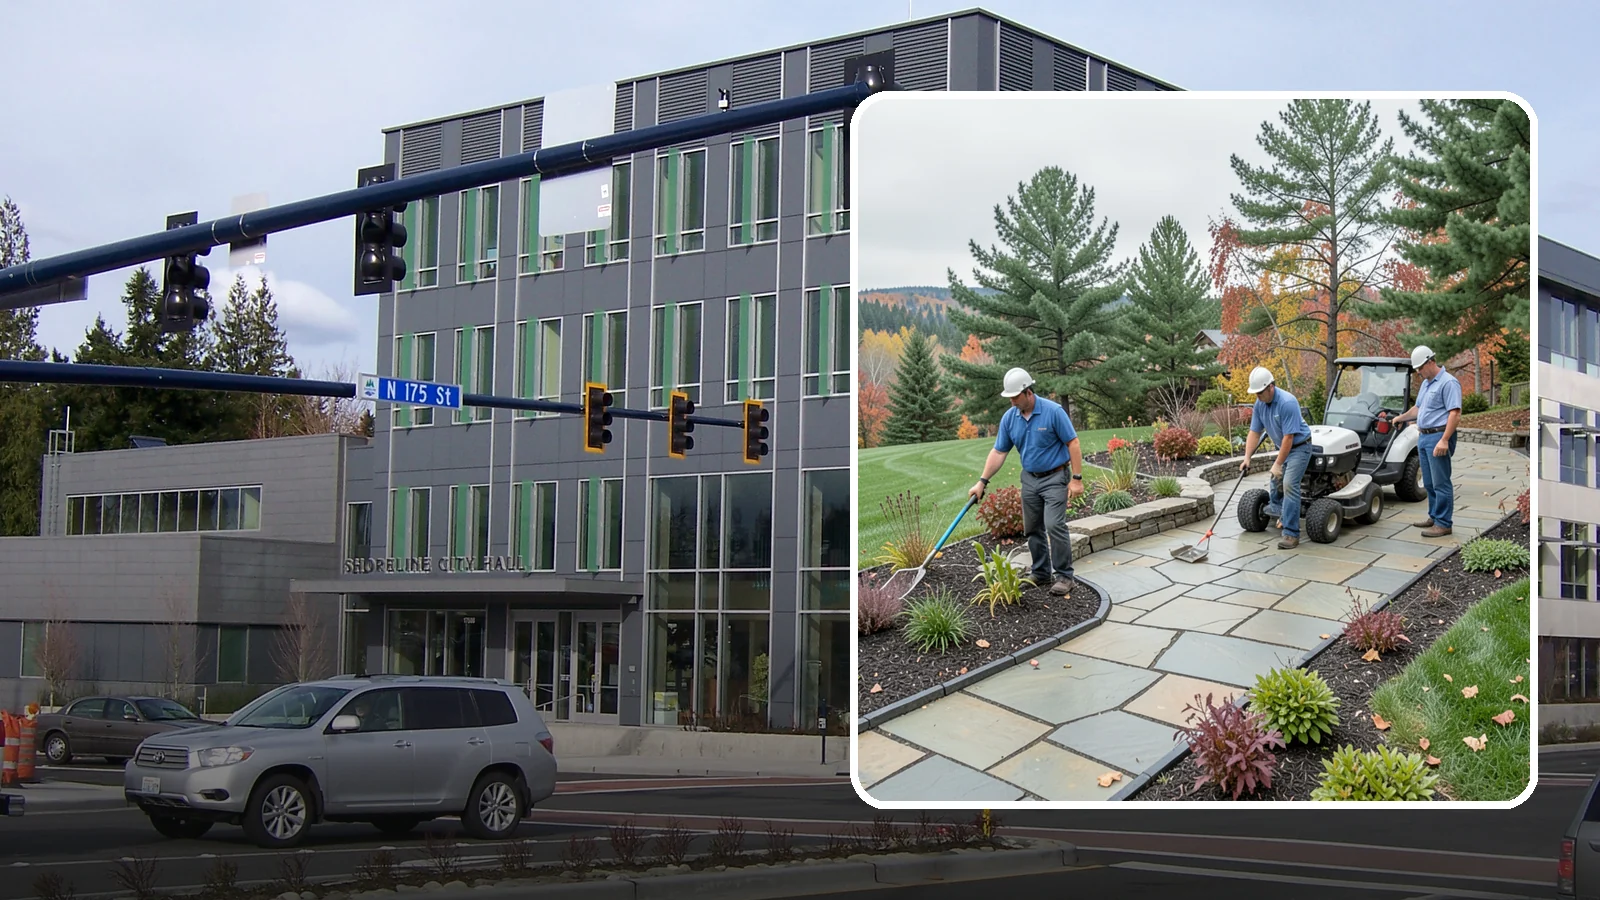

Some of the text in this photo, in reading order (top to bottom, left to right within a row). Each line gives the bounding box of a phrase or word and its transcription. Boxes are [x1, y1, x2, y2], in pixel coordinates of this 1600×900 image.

[387, 380, 452, 406] N 175 St
[344, 555, 525, 574] SHORELINE CITY HALL
